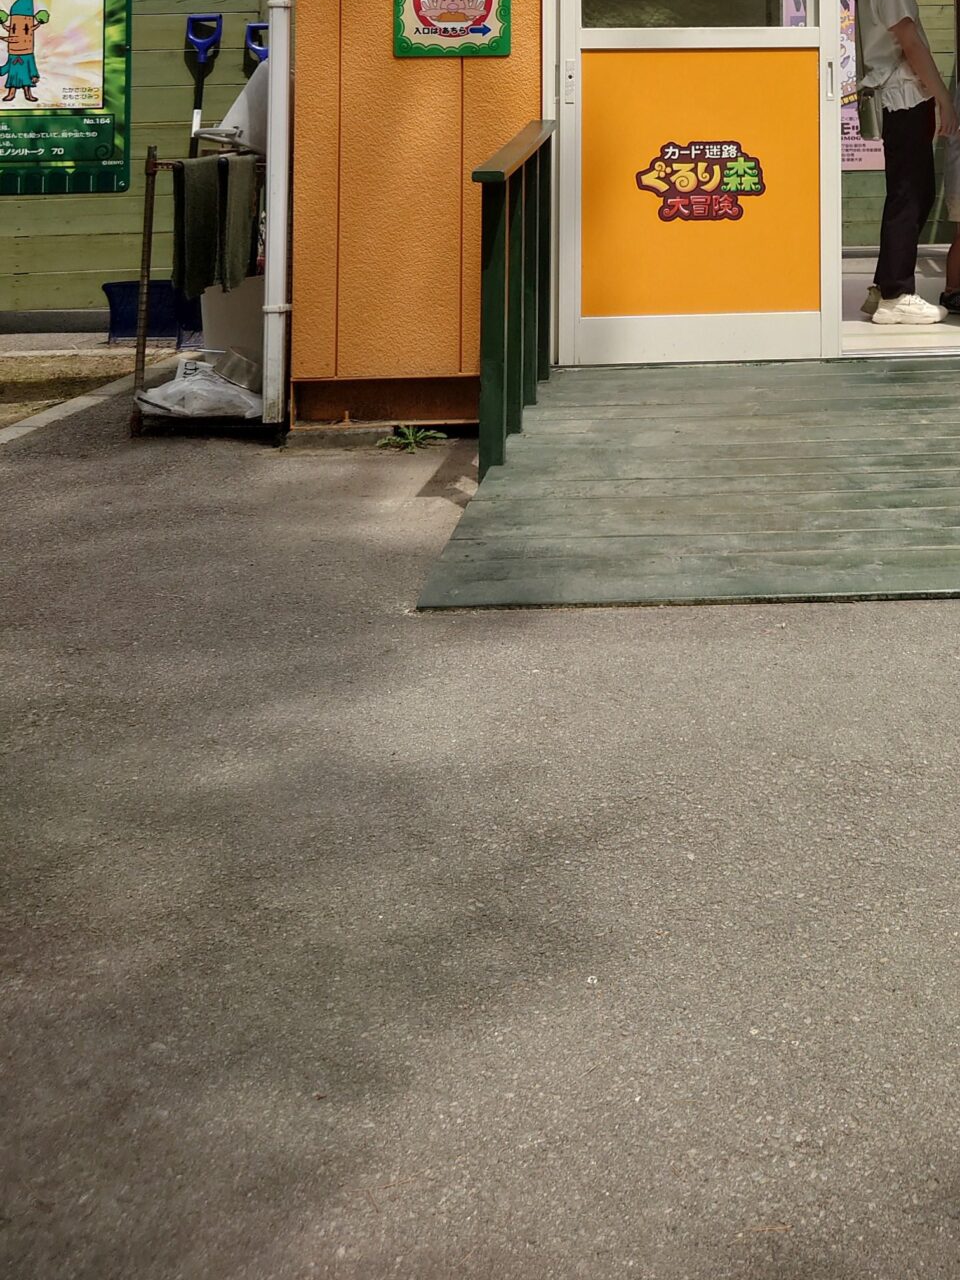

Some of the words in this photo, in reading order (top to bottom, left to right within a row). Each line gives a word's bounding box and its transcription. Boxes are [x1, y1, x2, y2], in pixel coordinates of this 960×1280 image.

[51, 147, 65, 155] 70
[640, 157, 762, 192] ぐるり森
[663, 195, 738, 217] 大冒険
